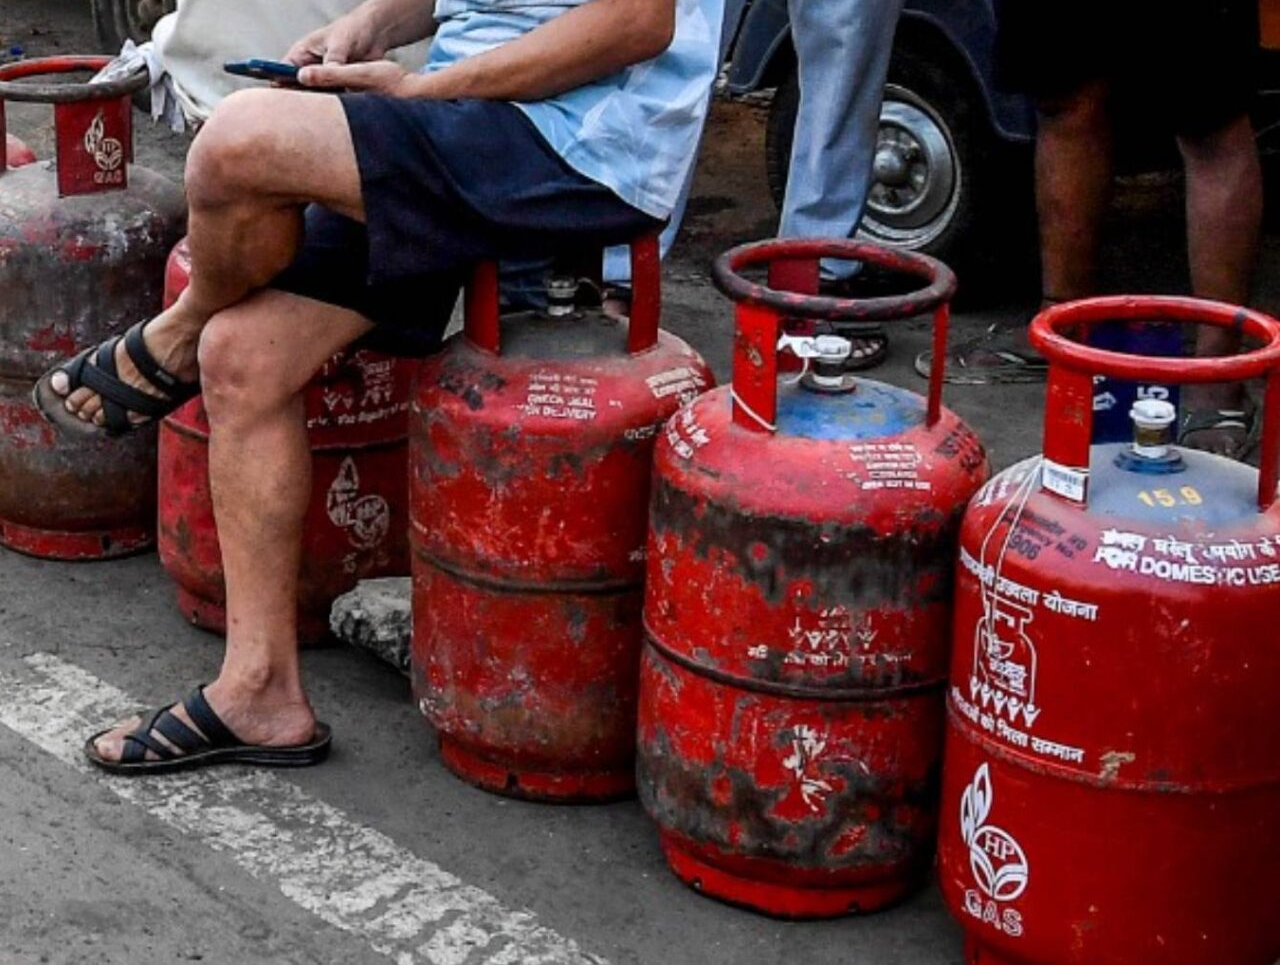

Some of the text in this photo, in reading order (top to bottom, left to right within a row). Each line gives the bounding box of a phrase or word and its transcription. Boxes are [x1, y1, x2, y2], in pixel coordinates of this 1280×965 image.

[1248, 564, 1280, 585] USE
[984, 830, 1016, 862] HP
[965, 888, 1024, 937] GAS
